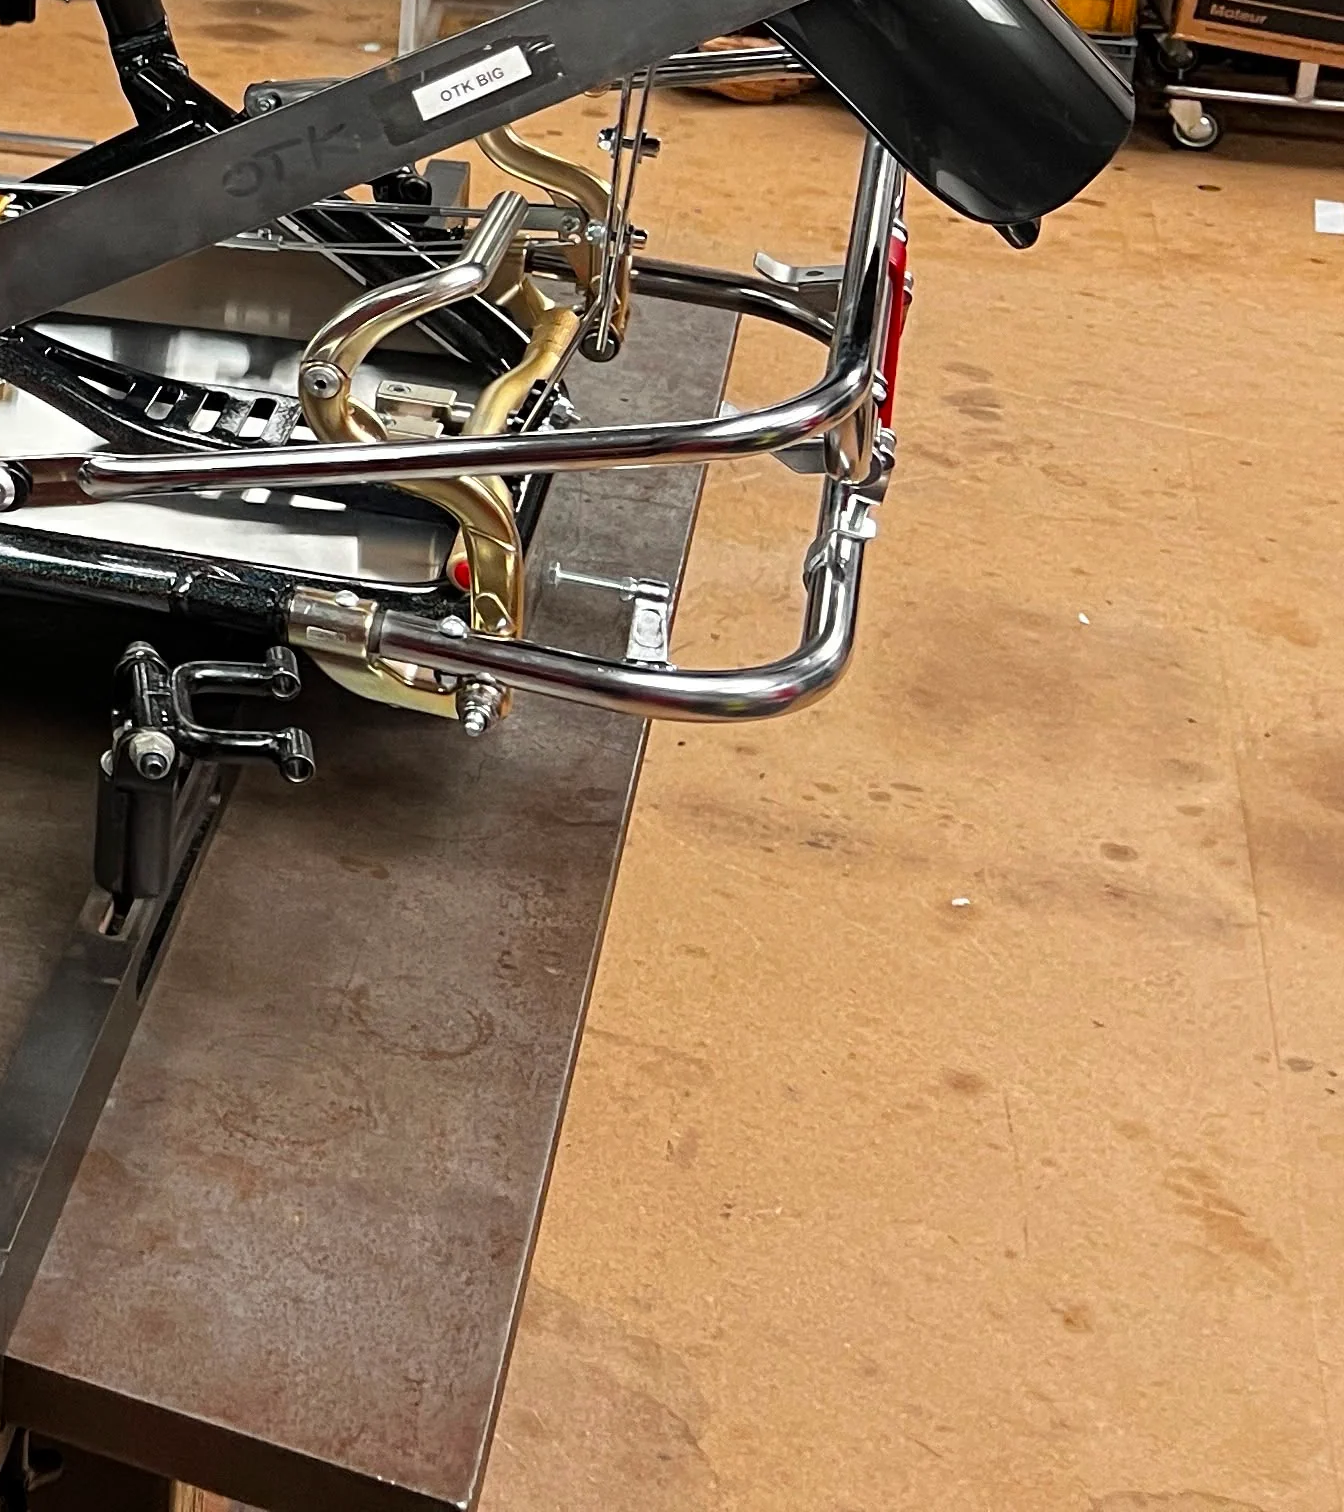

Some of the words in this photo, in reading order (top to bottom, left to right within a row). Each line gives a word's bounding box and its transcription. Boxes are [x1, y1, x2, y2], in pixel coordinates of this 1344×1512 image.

[1209, 2, 1269, 25] Moteur
[439, 80, 473, 103] OTK
[476, 66, 506, 88] BIG
